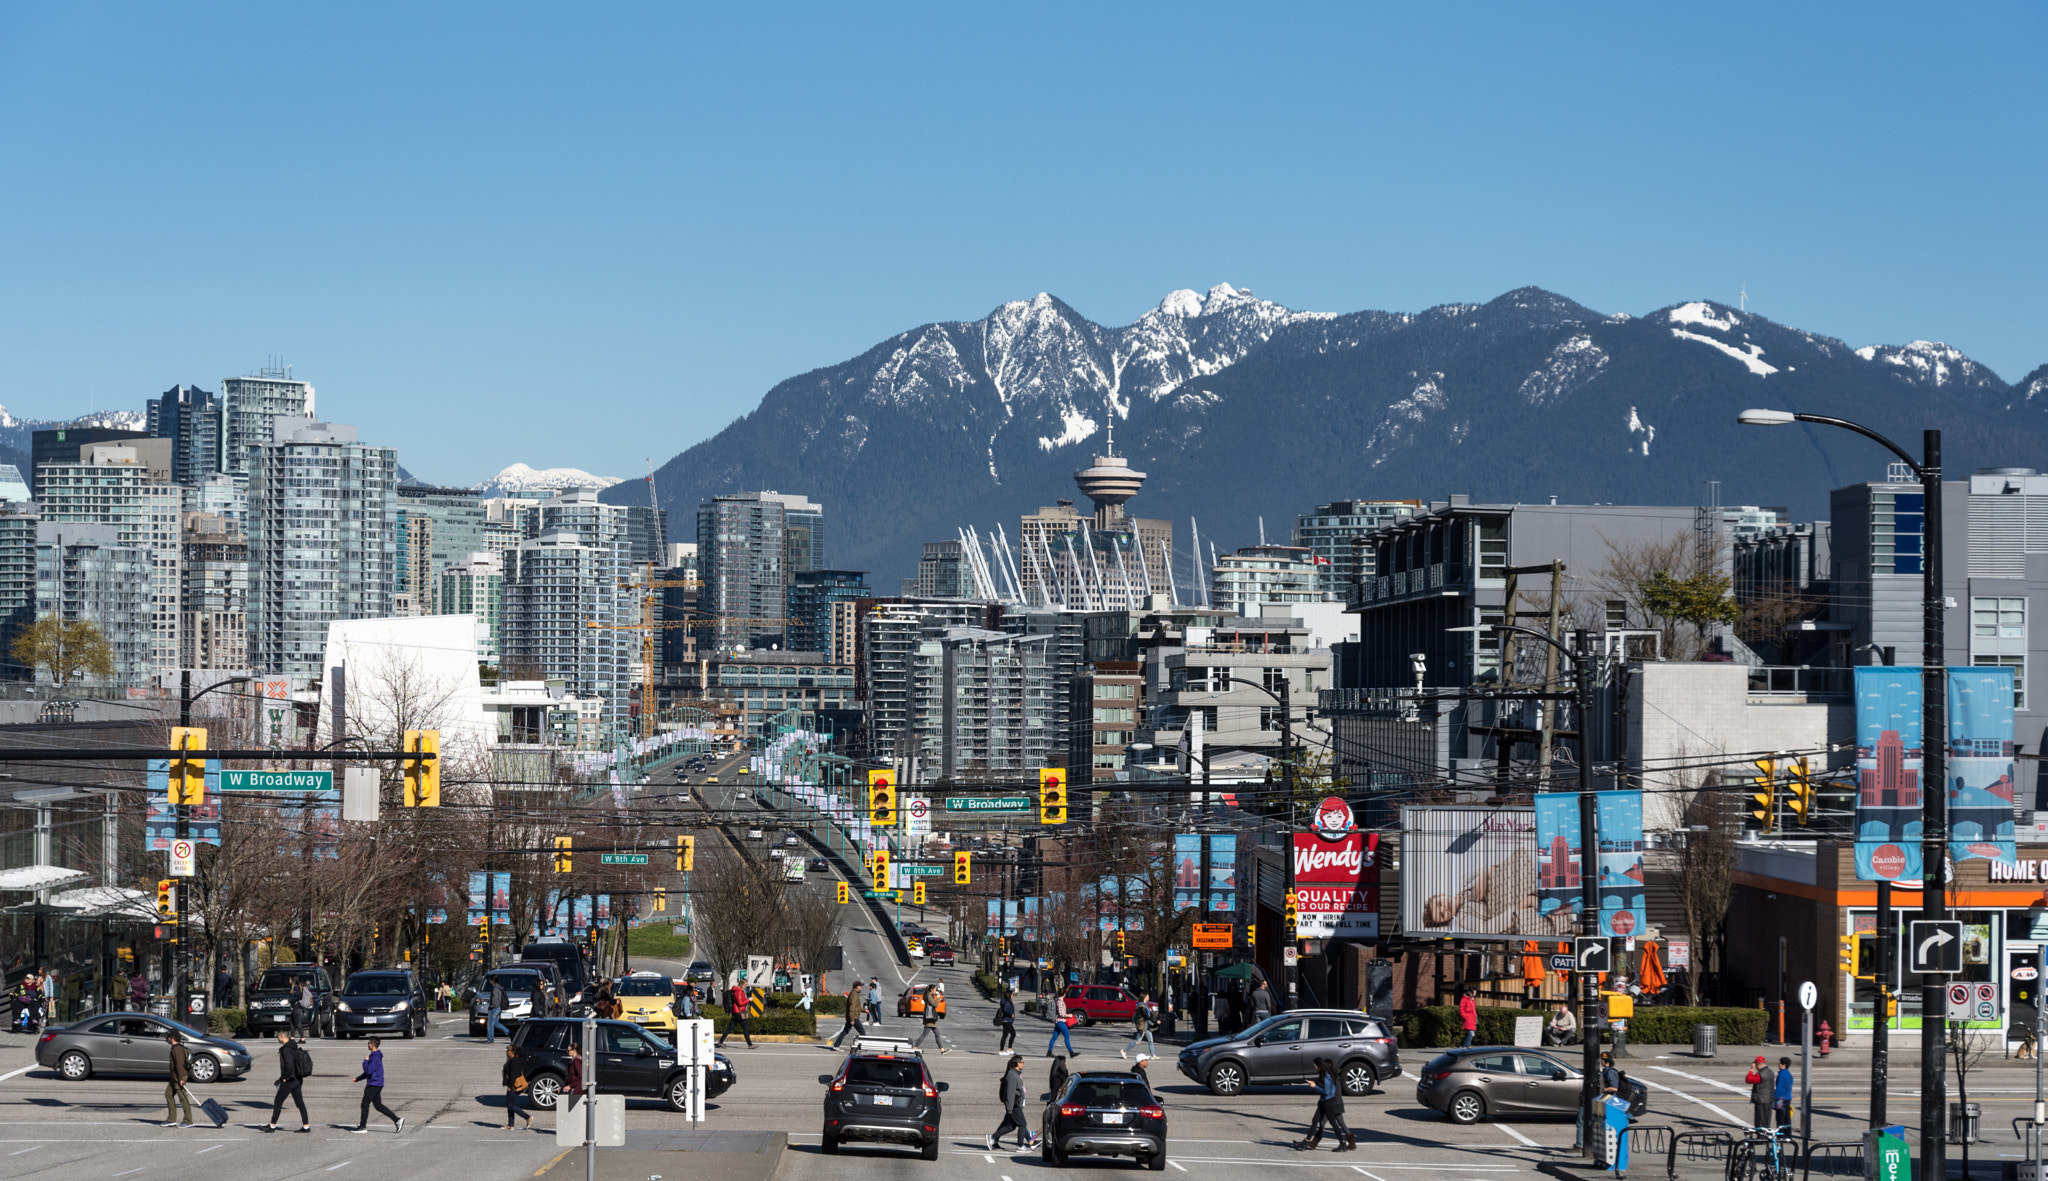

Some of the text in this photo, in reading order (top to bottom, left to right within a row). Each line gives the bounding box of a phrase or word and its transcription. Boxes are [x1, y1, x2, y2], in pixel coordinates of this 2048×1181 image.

[229, 772, 323, 790] W Broadway
[952, 799, 1024, 811] W Broadway
[604, 855, 613, 863] W
[615, 855, 628, 863] 8th
[1293, 840, 1376, 876] Wendy's
[1872, 855, 1905, 864] Cambie
[1991, 860, 2037, 880] HOME
[1297, 890, 1368, 903] QUALITY
[1297, 902, 1368, 911] IS OUR RECIPE
[1302, 913, 1346, 921] NOW HIRING
